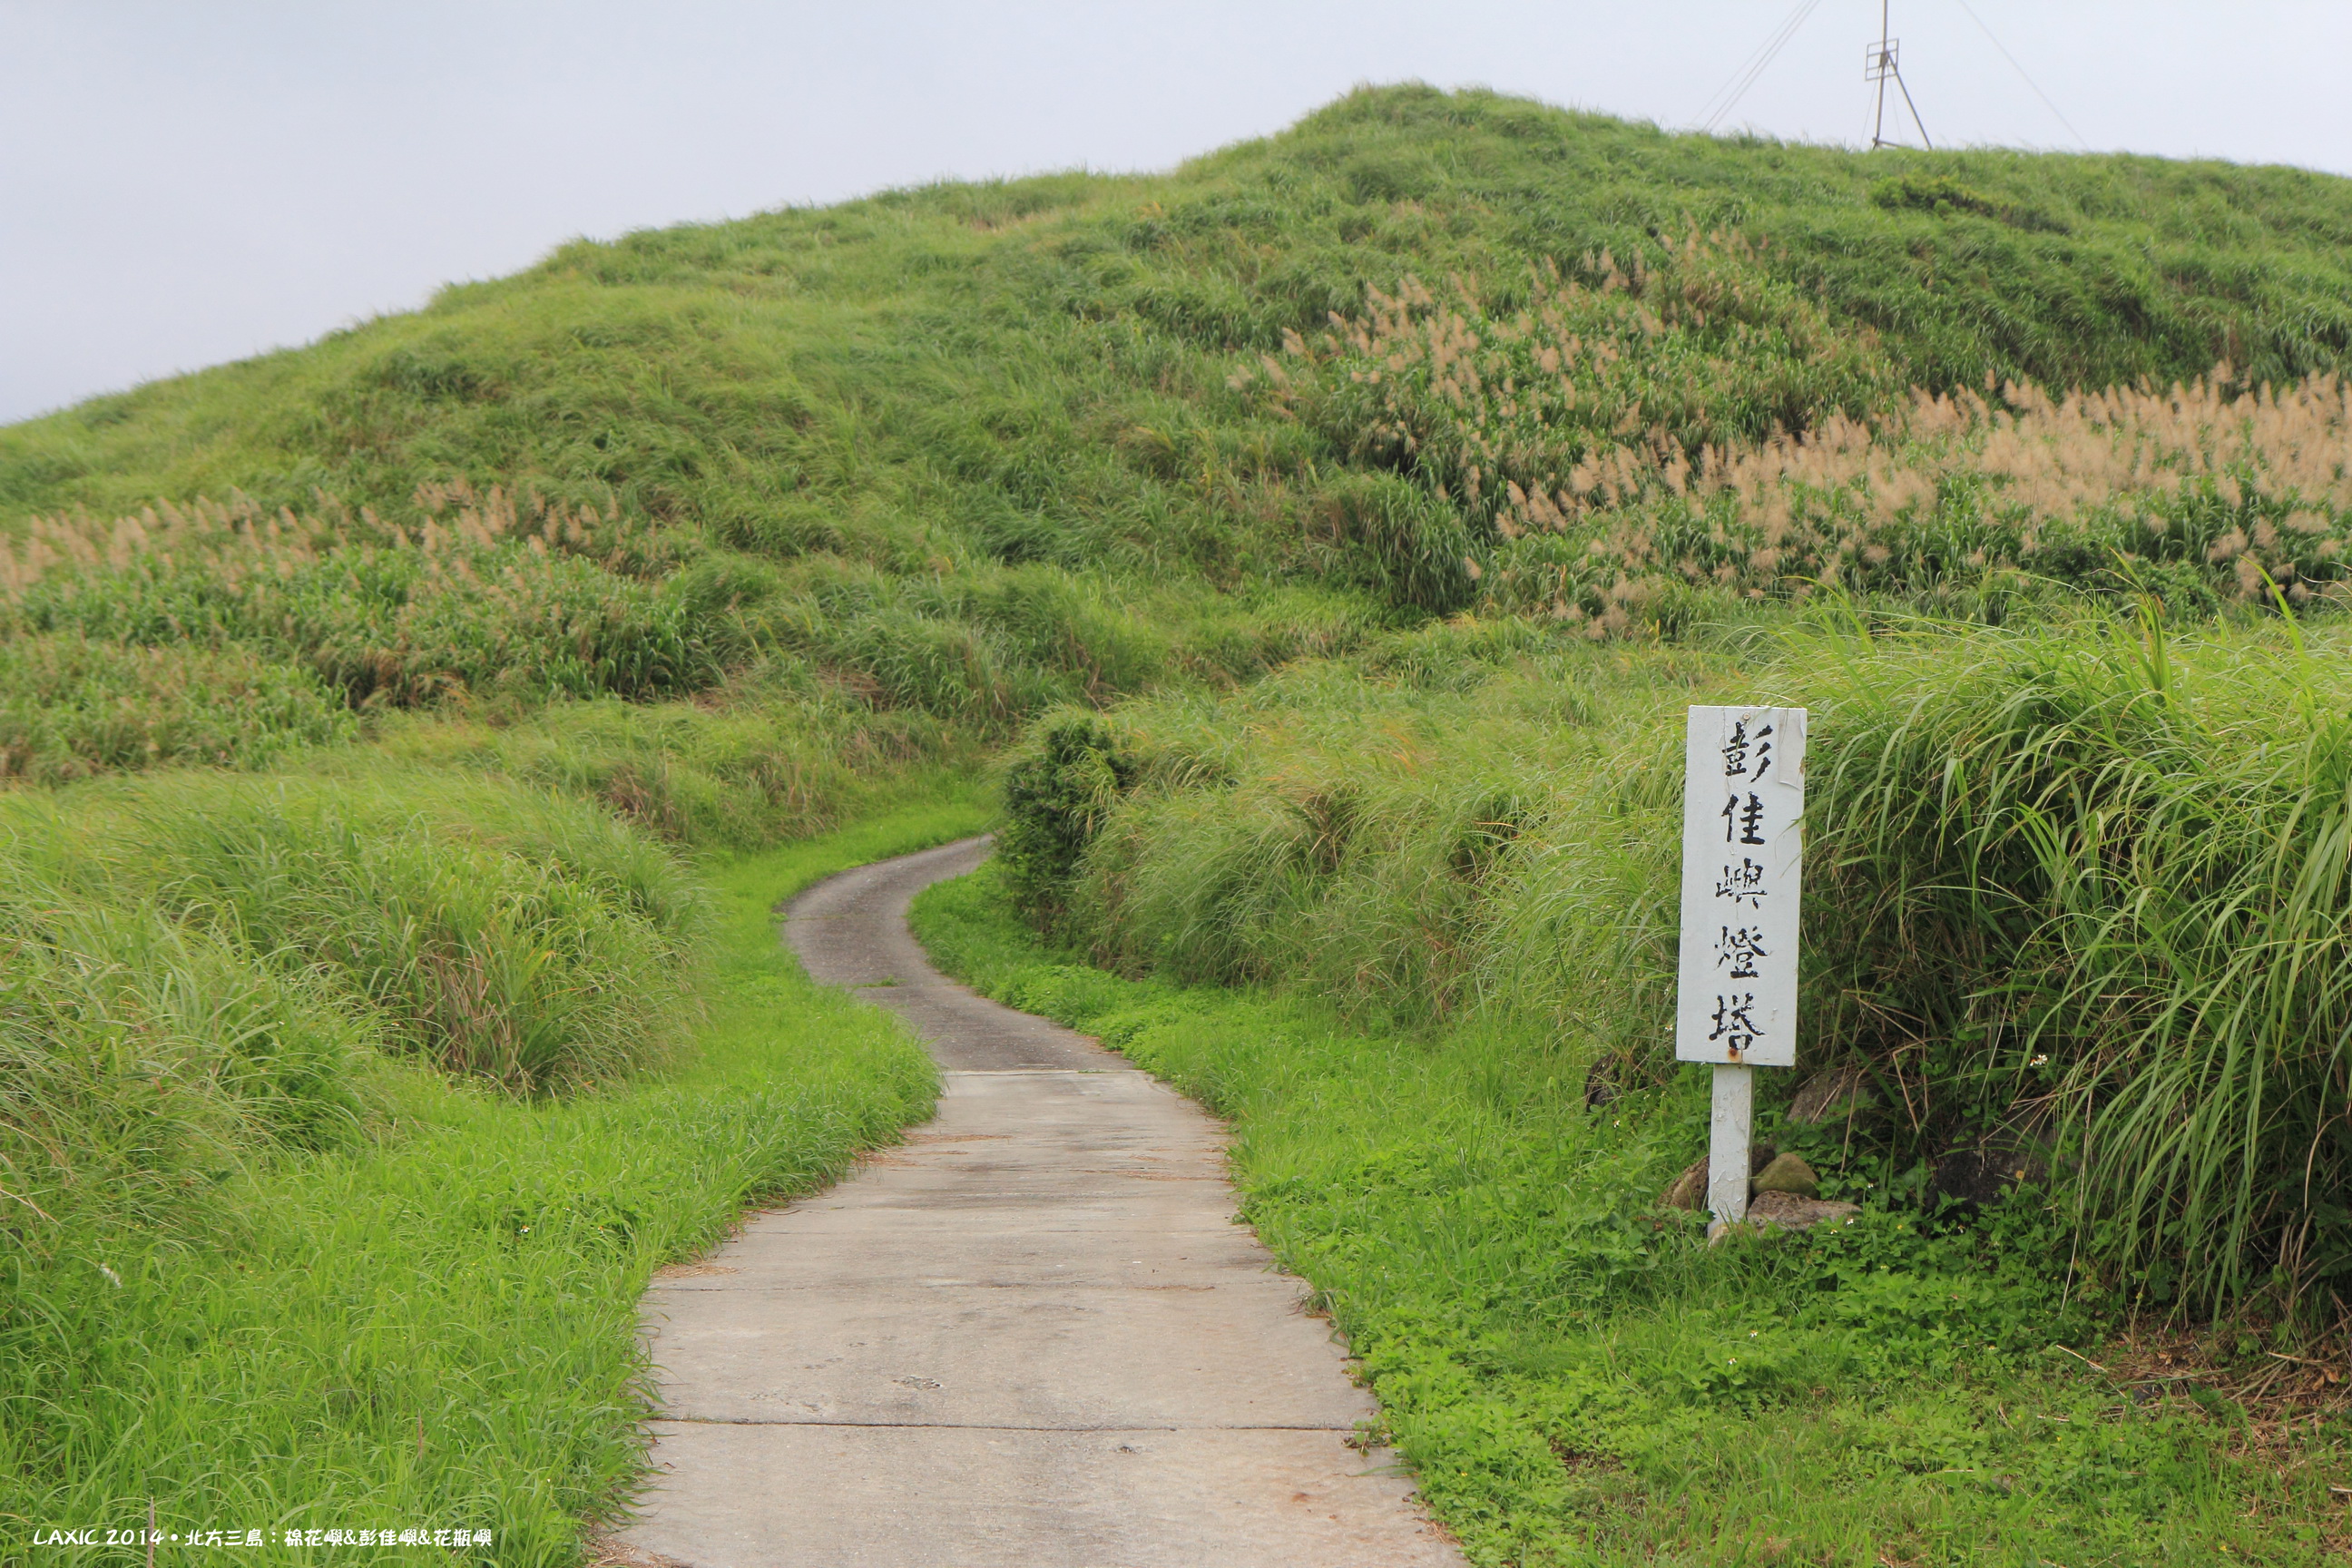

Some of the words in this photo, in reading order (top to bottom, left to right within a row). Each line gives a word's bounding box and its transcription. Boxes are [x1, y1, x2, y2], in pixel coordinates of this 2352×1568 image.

[1709, 720, 1774, 1052] 彭佳嶼燈塔
